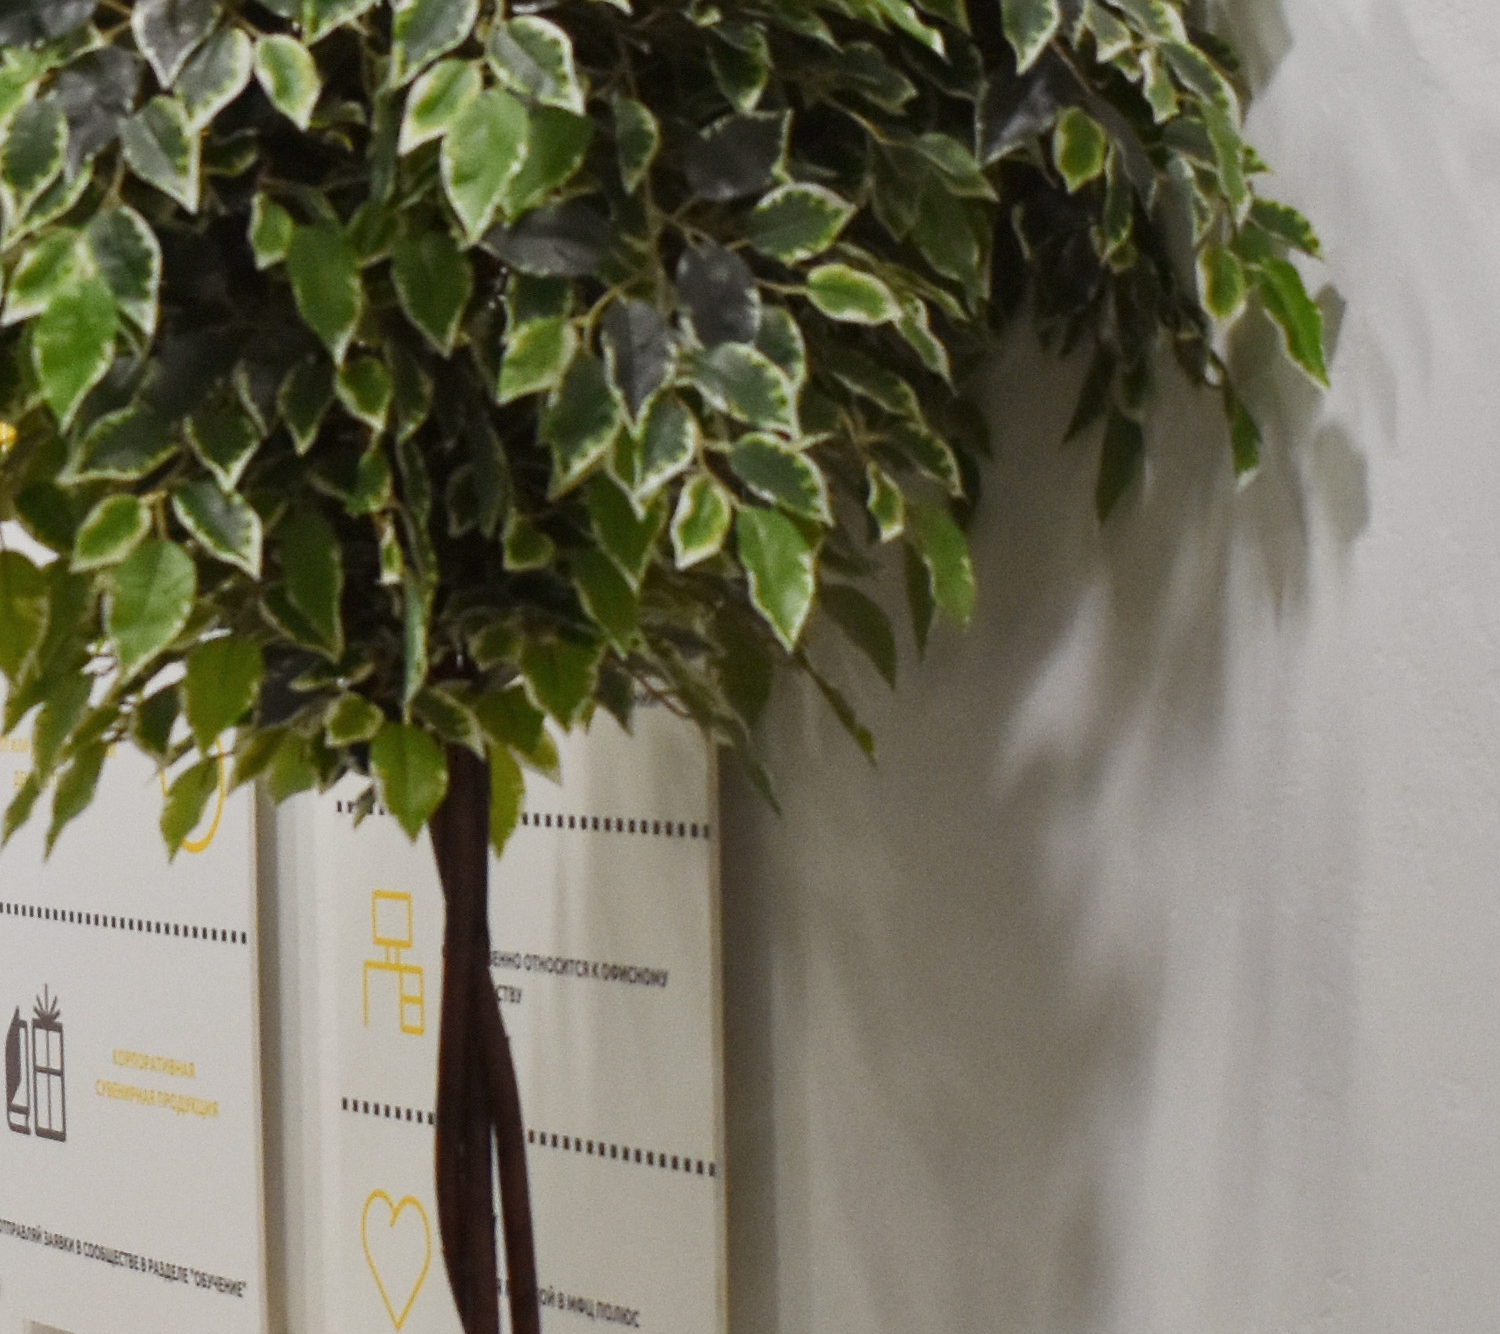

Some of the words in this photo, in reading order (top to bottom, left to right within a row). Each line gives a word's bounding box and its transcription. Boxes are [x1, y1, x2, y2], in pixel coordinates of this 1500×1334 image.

[43, 1230, 73, 1253] ЗАЯВКИ
[76, 1239, 81, 1255] В
[83, 1241, 138, 1270] СООБЩЕСТВЕ
[141, 1256, 145, 1272] В
[148, 1257, 188, 1283] РАЗДЕЛЕ
[190, 1268, 246, 1299] "ОБУЧЕНИЕ"
[558, 1292, 563, 1309] В
[567, 1295, 594, 1319] МФЦ
[597, 1301, 639, 1328] ПОЛЮС
